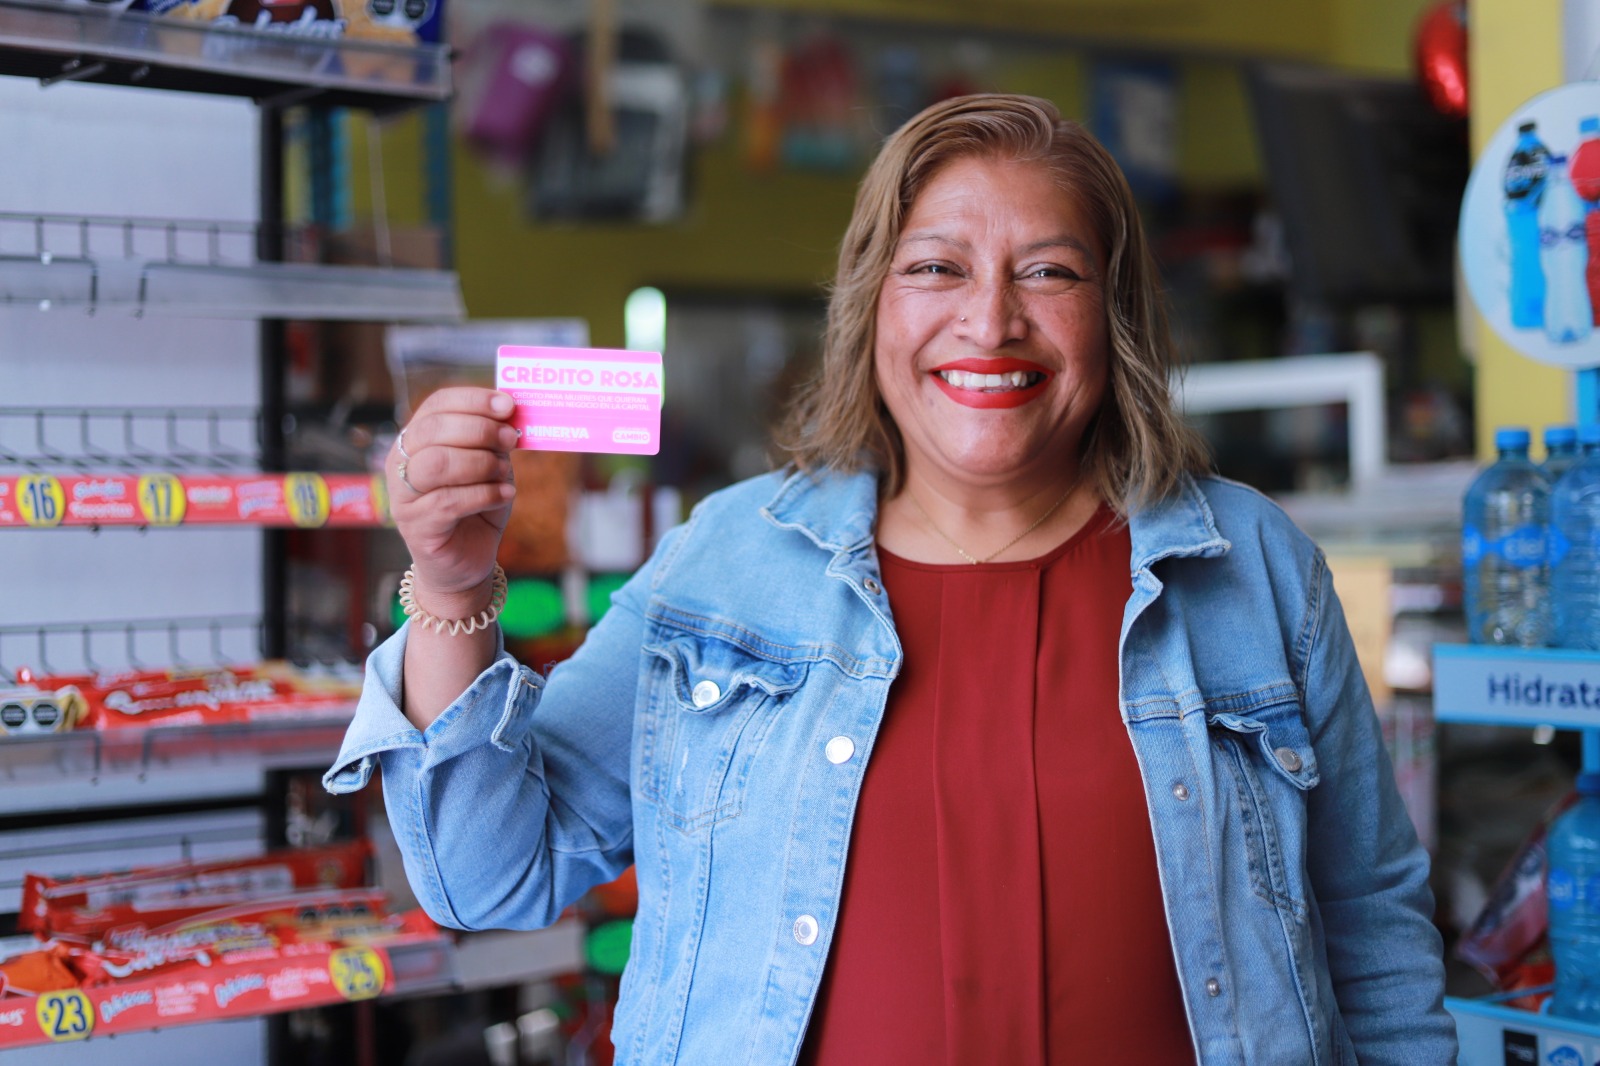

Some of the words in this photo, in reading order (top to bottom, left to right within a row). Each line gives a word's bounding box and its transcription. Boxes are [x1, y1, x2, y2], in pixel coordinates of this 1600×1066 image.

[501, 363, 594, 386] CRÉDITO
[600, 370, 659, 388] ROSA
[544, 393, 563, 401] PARA
[564, 394, 597, 402] MUJERES
[597, 395, 613, 403] QUE
[566, 400, 599, 409] NEGOCIO
[611, 402, 621, 410] LA
[621, 402, 651, 411] CAPITAL
[526, 425, 589, 439] MINERVA
[614, 432, 649, 441] CAMBIO
